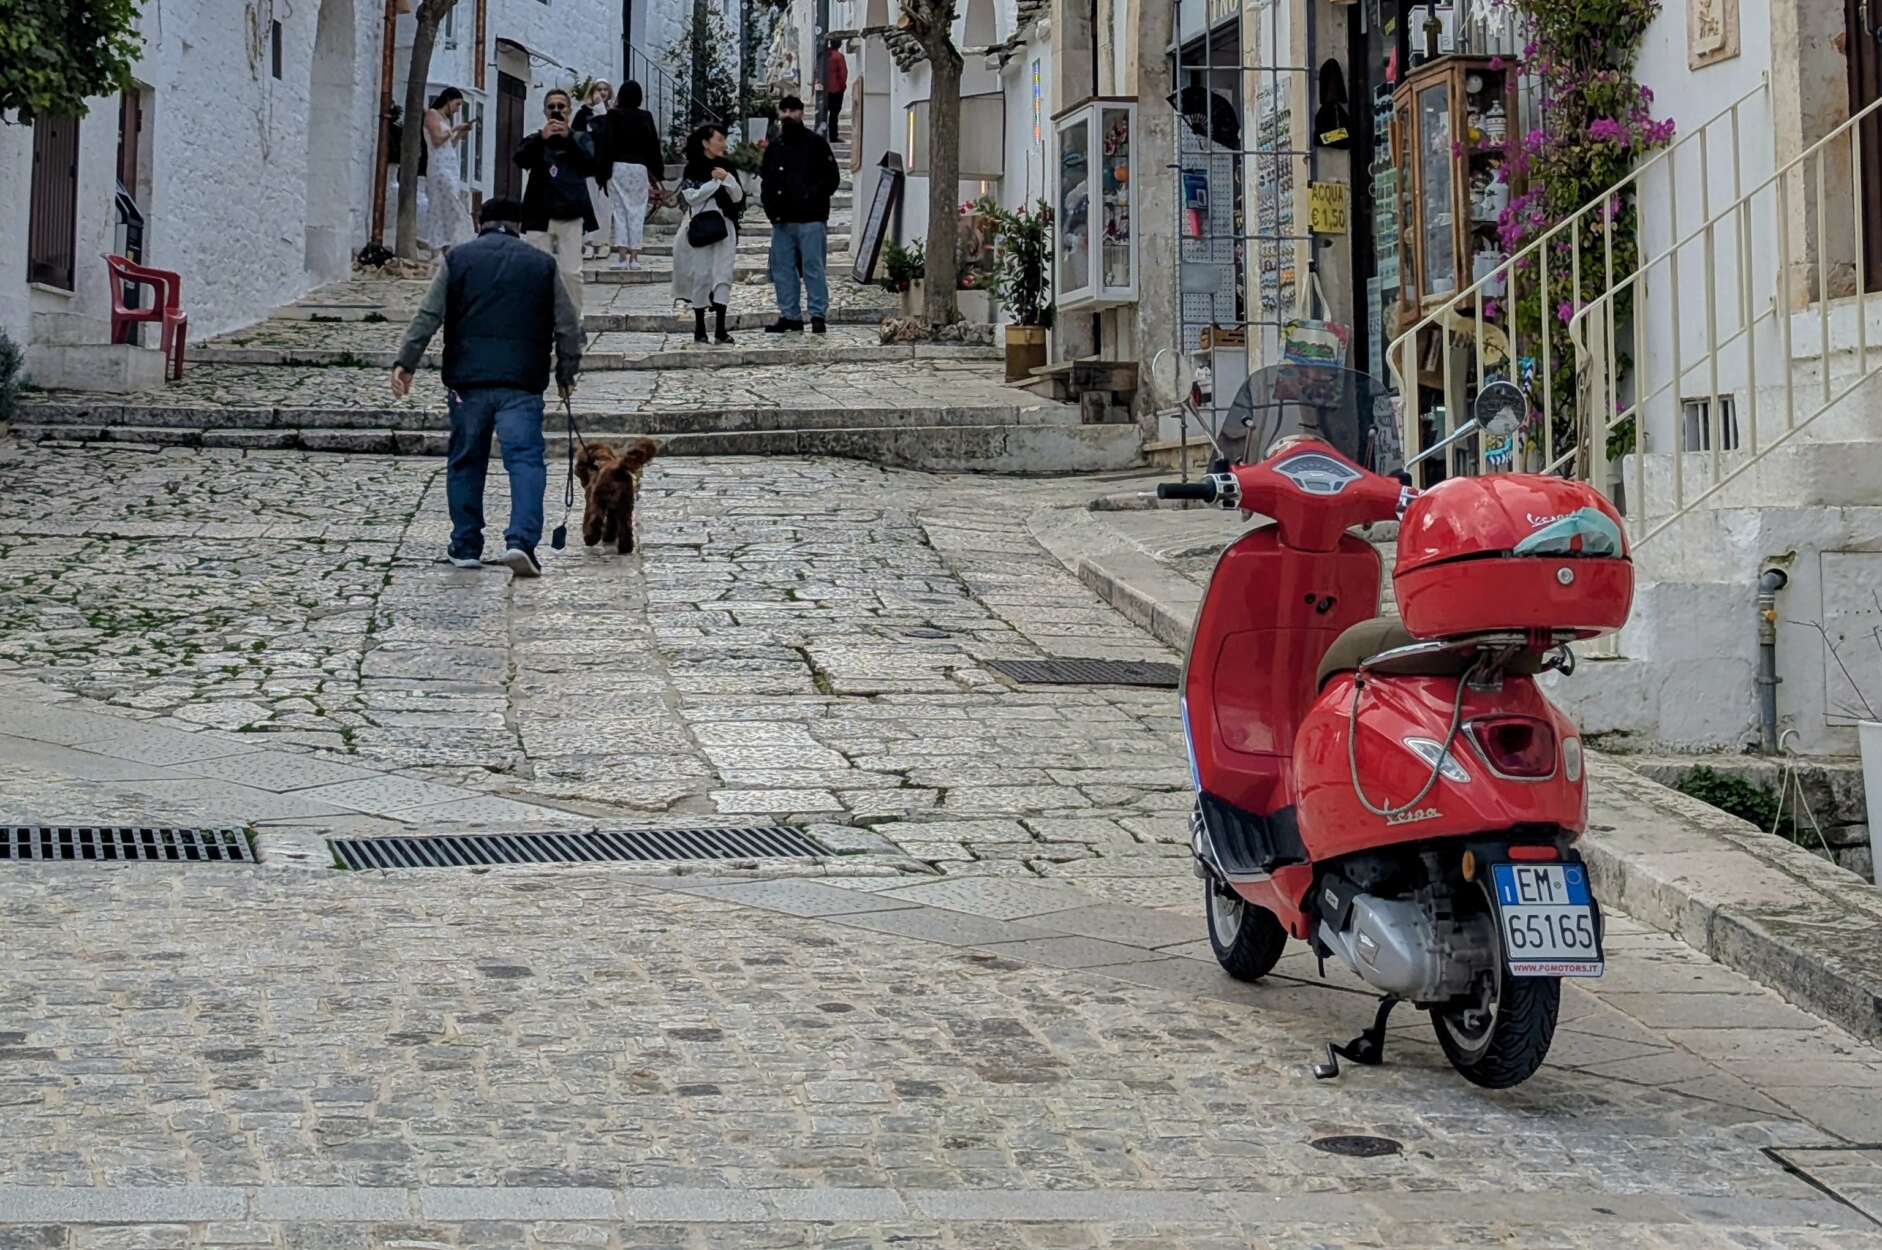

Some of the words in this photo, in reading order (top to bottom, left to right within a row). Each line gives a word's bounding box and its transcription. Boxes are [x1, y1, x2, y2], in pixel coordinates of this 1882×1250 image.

[1311, 184, 1344, 206] ACQUA
[1311, 207, 1320, 227] €
[1322, 208, 1345, 231] 1,50
[1383, 797, 1443, 826] Vespa
[1516, 868, 1554, 902] EM
[1508, 914, 1593, 949] 65165
[1513, 963, 1599, 973] WWW.PGMOTORS.IT
